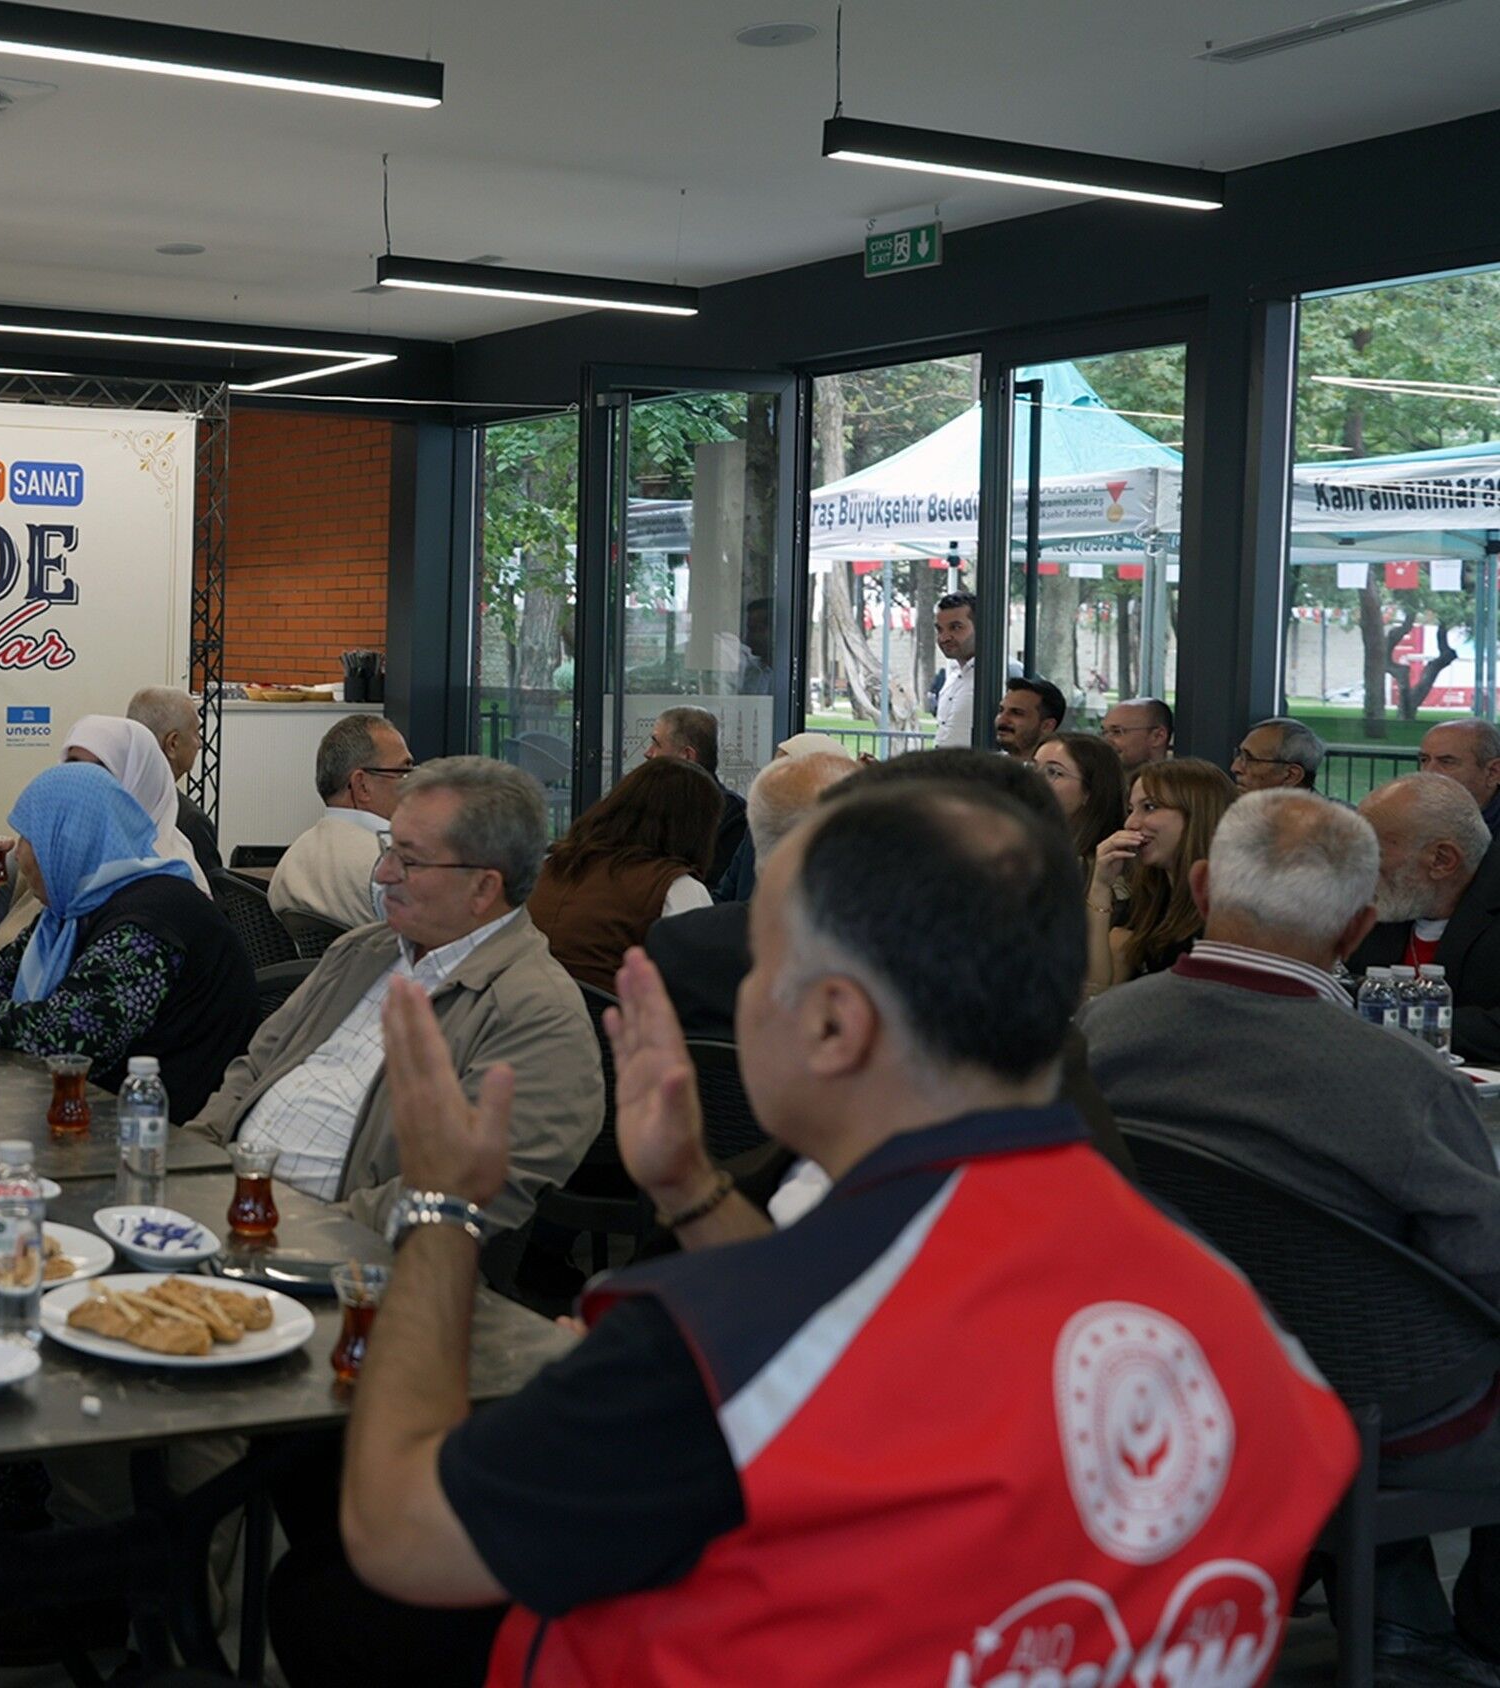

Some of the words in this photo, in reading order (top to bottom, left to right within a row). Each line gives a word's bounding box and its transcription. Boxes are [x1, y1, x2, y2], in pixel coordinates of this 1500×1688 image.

[872, 252, 891, 265] EXIT
[14, 469, 79, 498] SANAT
[839, 493, 924, 532] Büyükşehir
[6, 726, 51, 736] unesco
